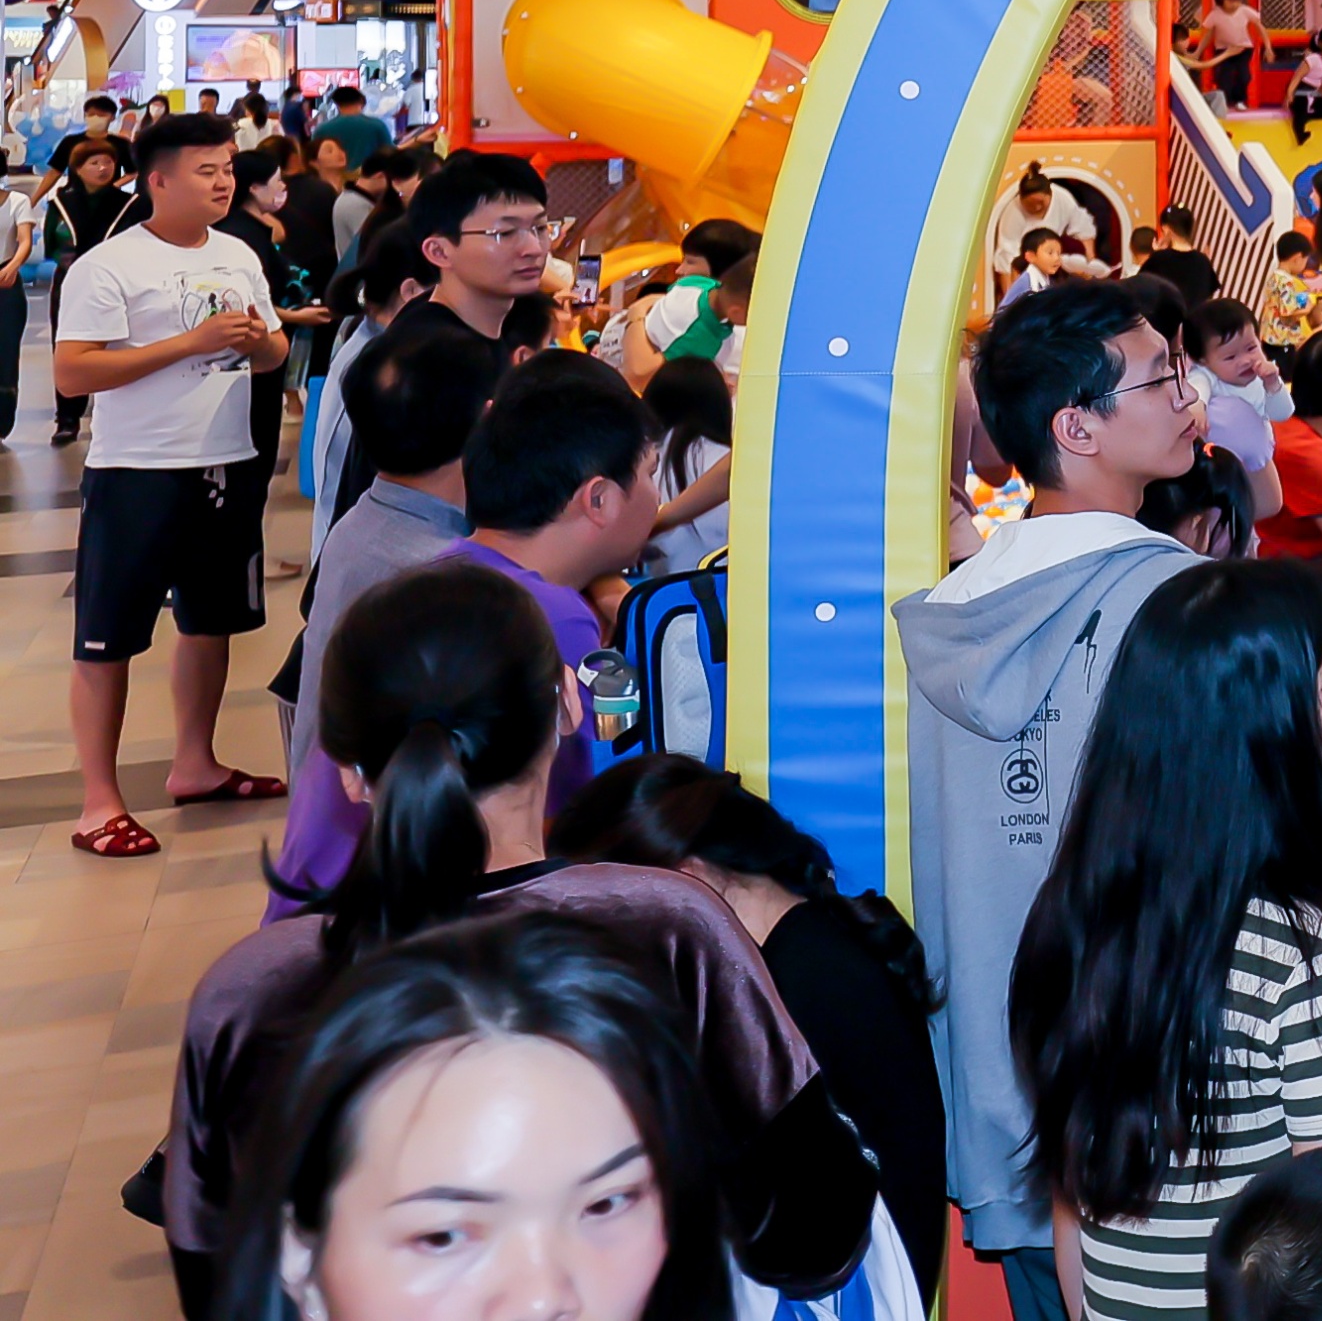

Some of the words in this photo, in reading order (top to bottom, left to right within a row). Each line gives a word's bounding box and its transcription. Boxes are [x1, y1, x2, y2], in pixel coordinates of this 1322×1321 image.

[1009, 727, 1043, 742] OKYO
[1001, 812, 1049, 828] LONDON
[1009, 832, 1043, 845] PARIS
